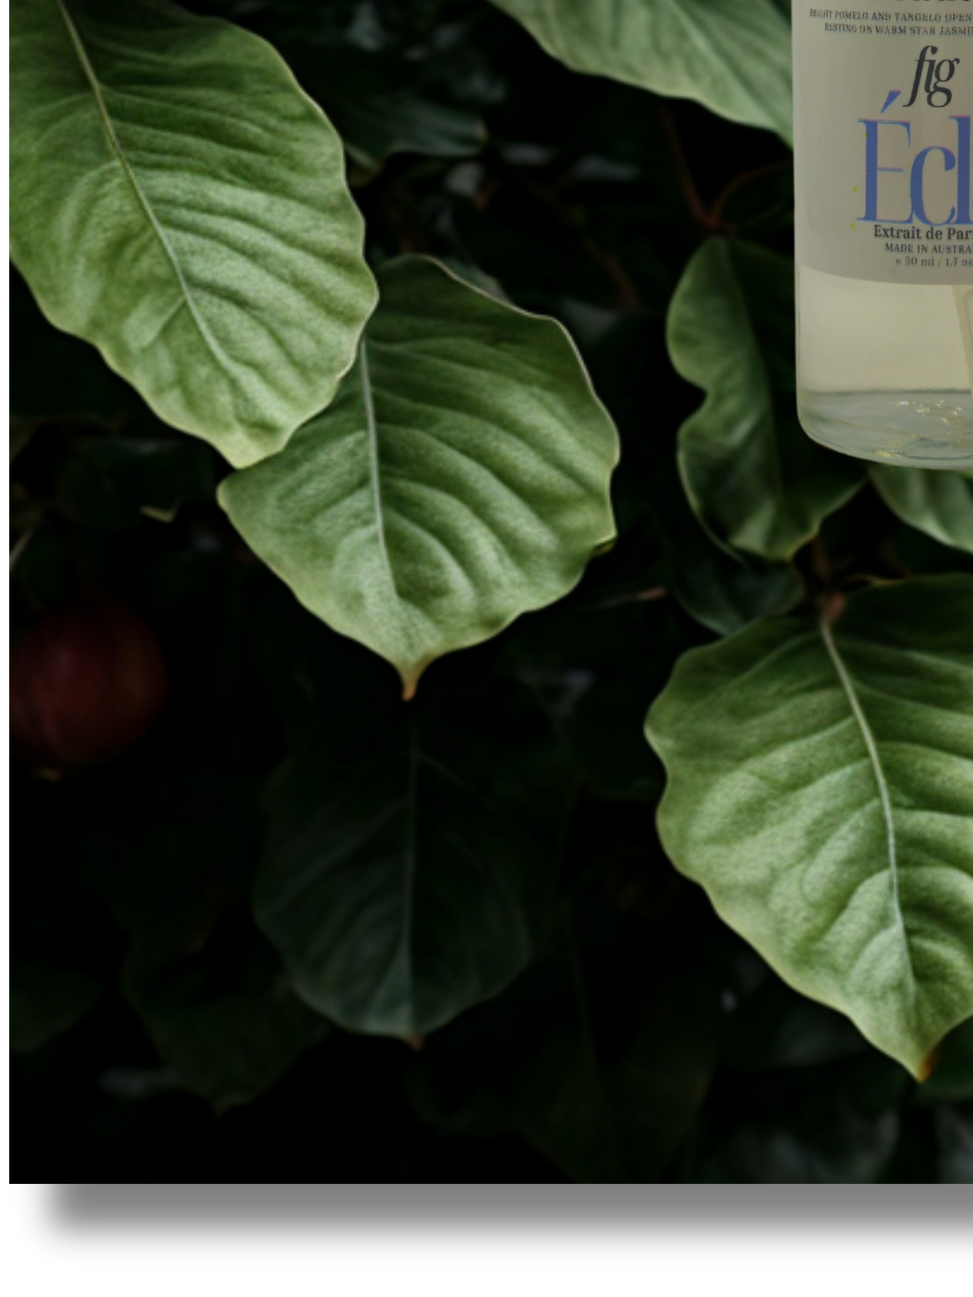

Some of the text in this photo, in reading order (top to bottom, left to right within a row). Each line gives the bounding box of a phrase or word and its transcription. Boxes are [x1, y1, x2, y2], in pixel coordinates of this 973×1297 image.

[835, 10, 869, 21] POMELO
[871, 11, 891, 21] AND
[893, 12, 941, 22] TANGELO
[944, 13, 973, 23] OPEN
[824, 22, 857, 33] RESTING
[859, 24, 872, 34] ON
[875, 25, 907, 35] WARM
[909, 26, 936, 35] STAR
[903, 45, 960, 107] fig
[873, 224, 922, 240] Extrait
[925, 226, 943, 240] de
[885, 242, 913, 253] MADE
[917, 244, 928, 254] IN
[905, 256, 918, 266] 50
[921, 256, 935, 266] ml
[946, 257, 958, 266] 1.7
